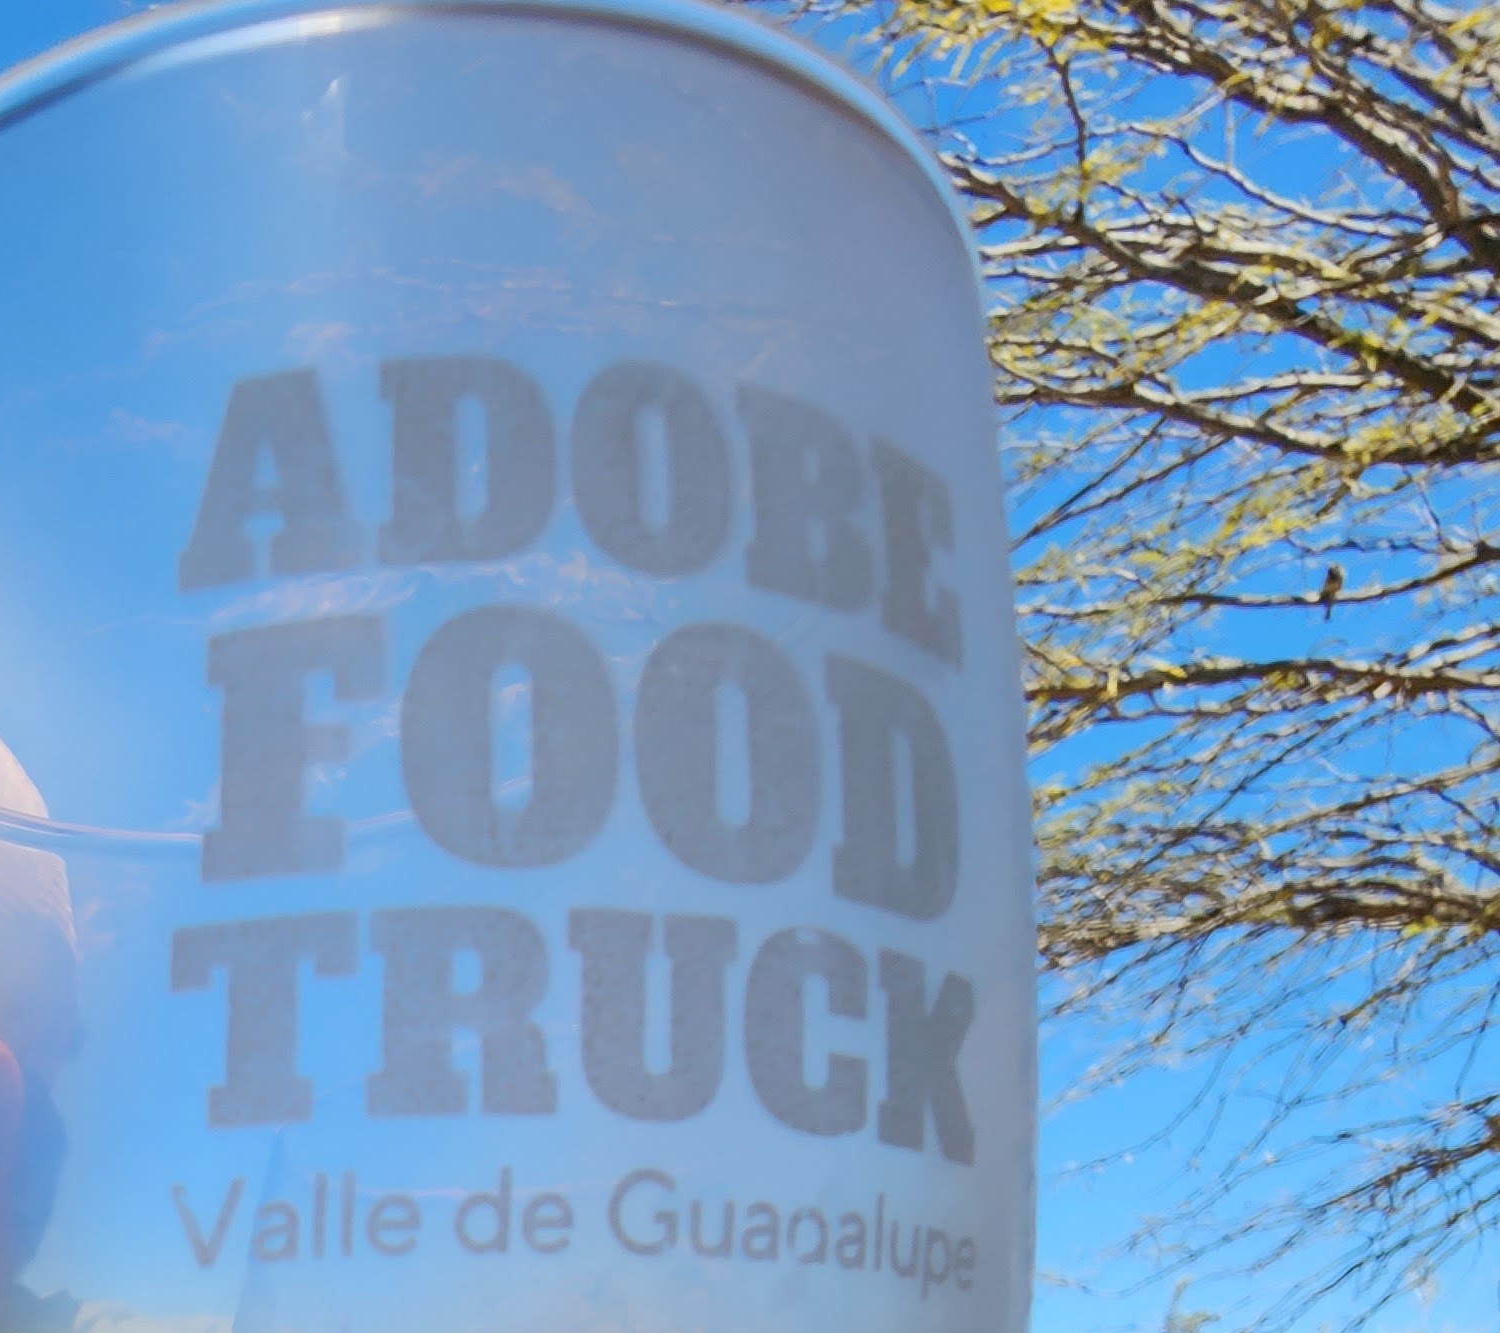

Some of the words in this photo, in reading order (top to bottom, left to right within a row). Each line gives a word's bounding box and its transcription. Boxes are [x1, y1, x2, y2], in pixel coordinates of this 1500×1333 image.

[177, 355, 963, 672] ADOBE
[201, 604, 960, 921] FOOD
[170, 905, 976, 1167] TRUCK
[171, 1170, 421, 1268] Valle
[454, 1167, 574, 1255] de
[608, 1168, 978, 1298] Guadalupe
